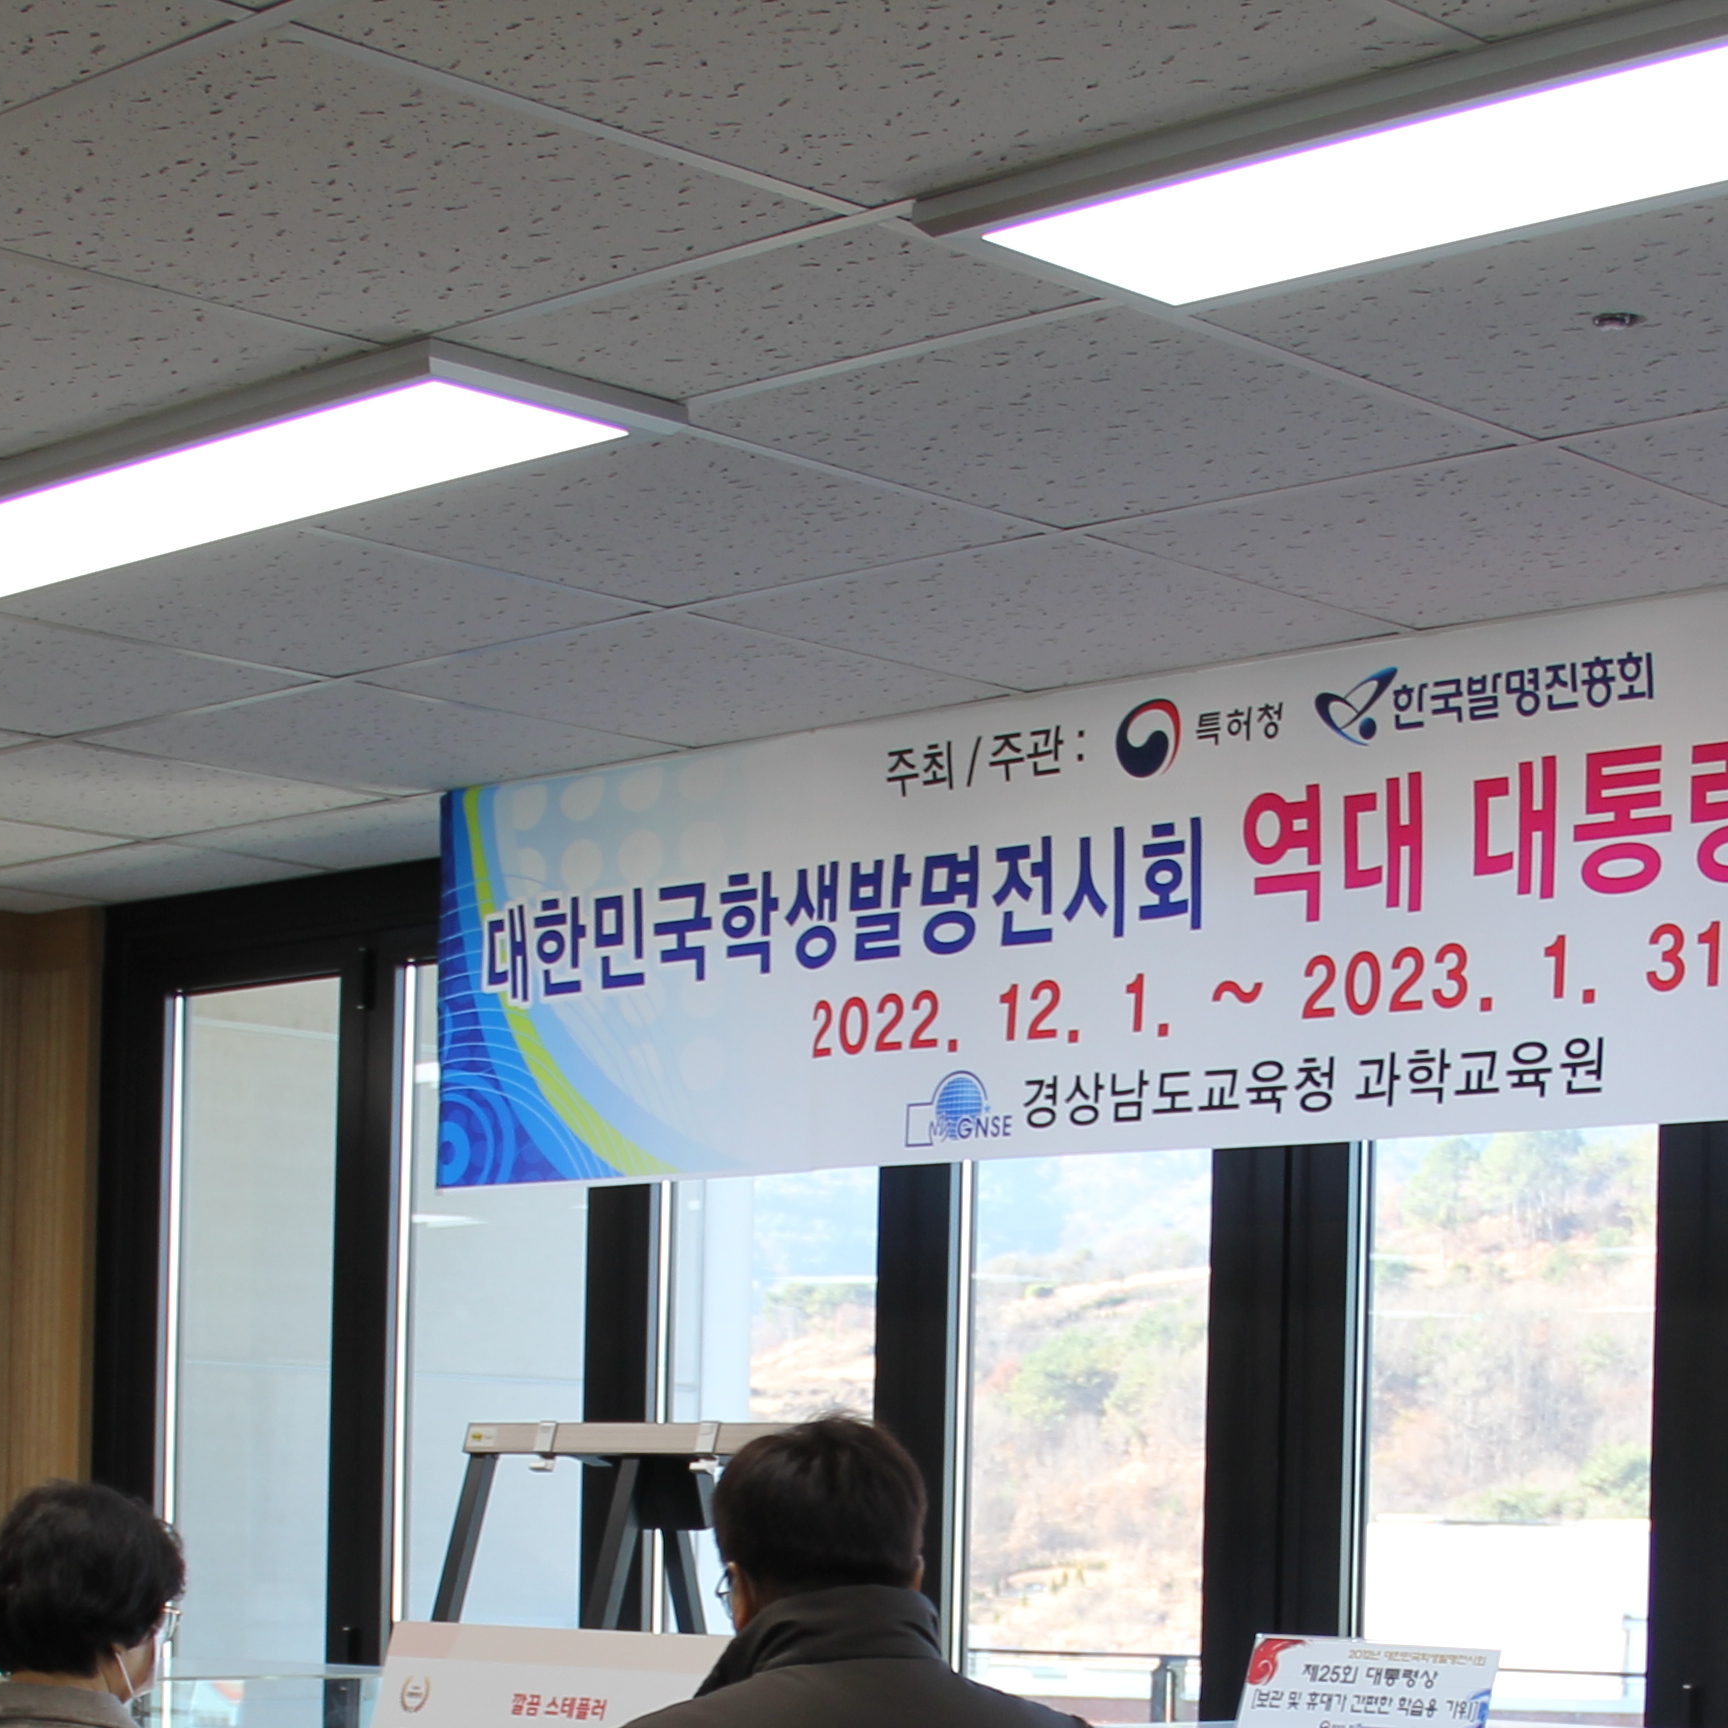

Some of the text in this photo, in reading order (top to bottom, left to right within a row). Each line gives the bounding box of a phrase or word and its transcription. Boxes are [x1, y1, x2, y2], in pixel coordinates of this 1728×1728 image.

[1392, 652, 1655, 731] 한국발명진흥회
[1195, 701, 1284, 747] 특허청
[486, 816, 1202, 1003] 대한민국학생발명전시회
[1242, 772, 1423, 923] 역대
[811, 989, 960, 1059] 2022.
[999, 979, 1081, 1044] 12.
[1125, 972, 1170, 1038] 1.
[1301, 942, 1494, 1021] 2023.
[1542, 934, 1596, 1004] 1.
[1022, 1036, 1607, 1131] 경상남도교육청 과학교육원
[957, 1115, 1013, 1139] GNSE
[1302, 1663, 1438, 1690] 제25회 대통령상
[544, 1696, 608, 1721] 스테플러
[1288, 1691, 1303, 1710] 및
[1305, 1690, 1347, 1713] 휴대가
[1350, 1694, 1393, 1715] 간편한
[1397, 1696, 1439, 1718] 학습용
